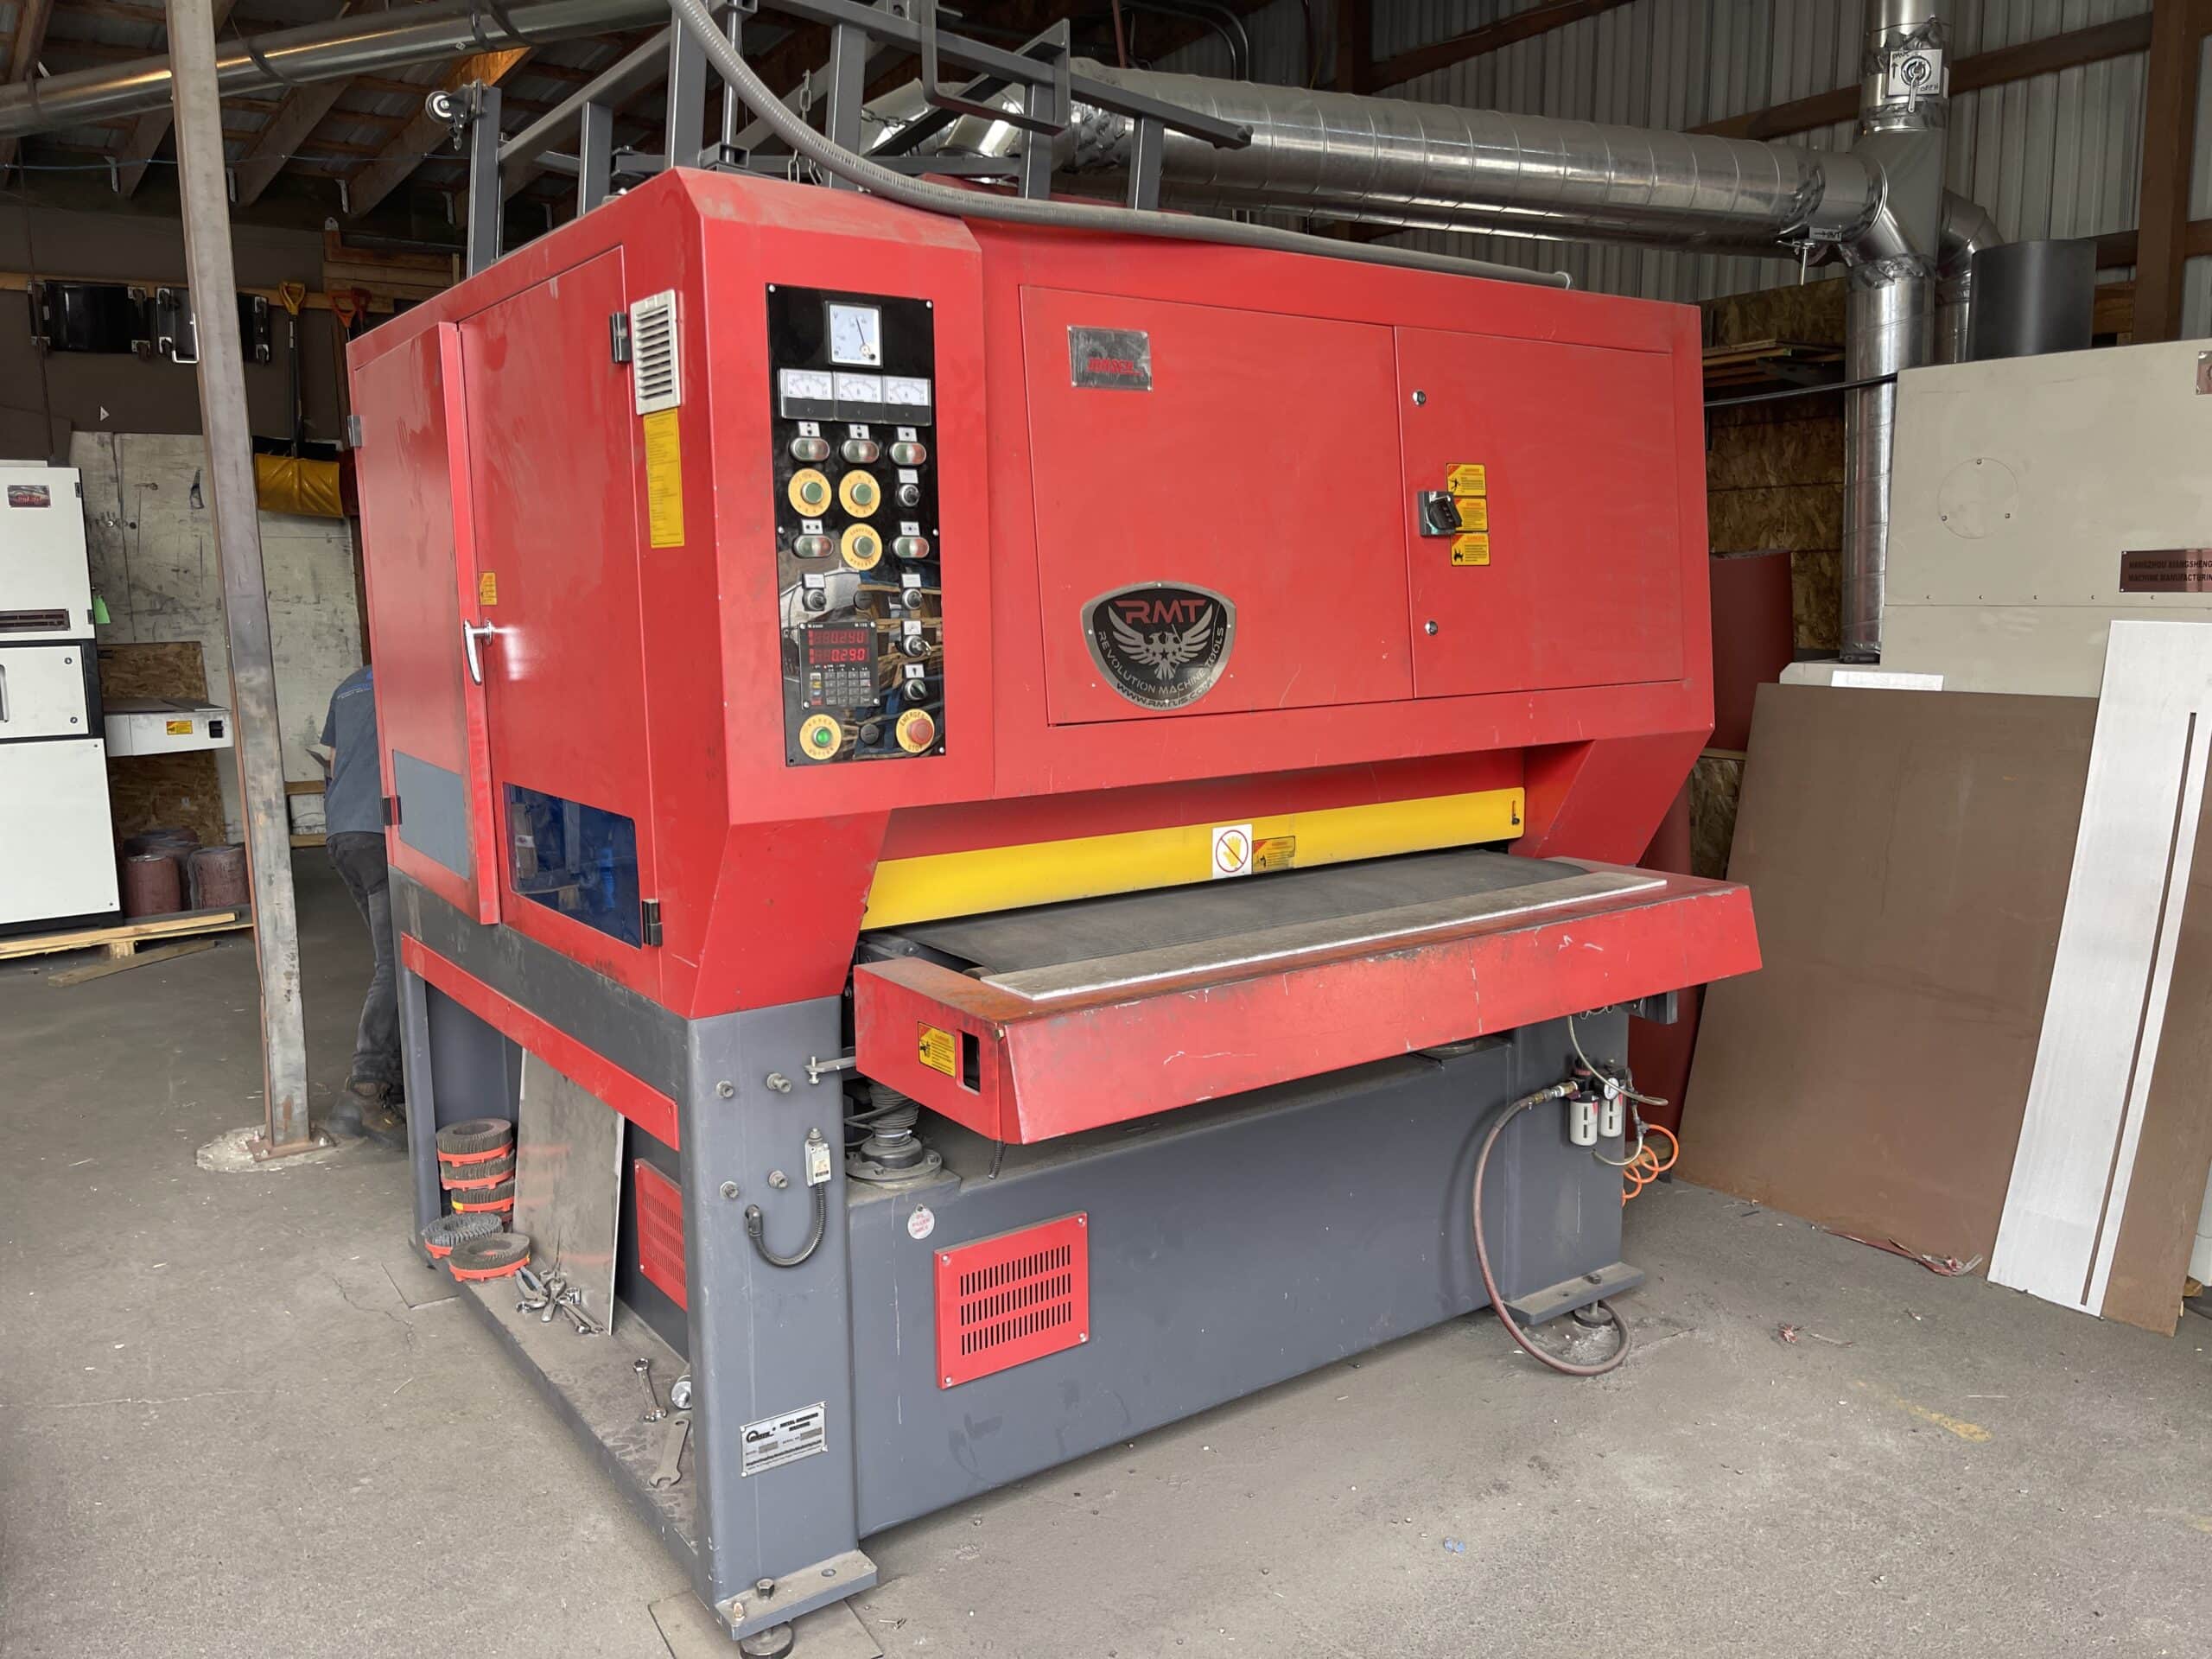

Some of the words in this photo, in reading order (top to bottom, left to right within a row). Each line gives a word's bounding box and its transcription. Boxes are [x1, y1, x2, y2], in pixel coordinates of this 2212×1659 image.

[1113, 599, 1207, 624] RMT
[1097, 631, 1157, 693] REVOLUTION
[1158, 670, 1206, 695] MACHINE
[1204, 626, 1224, 671] TOOLS
